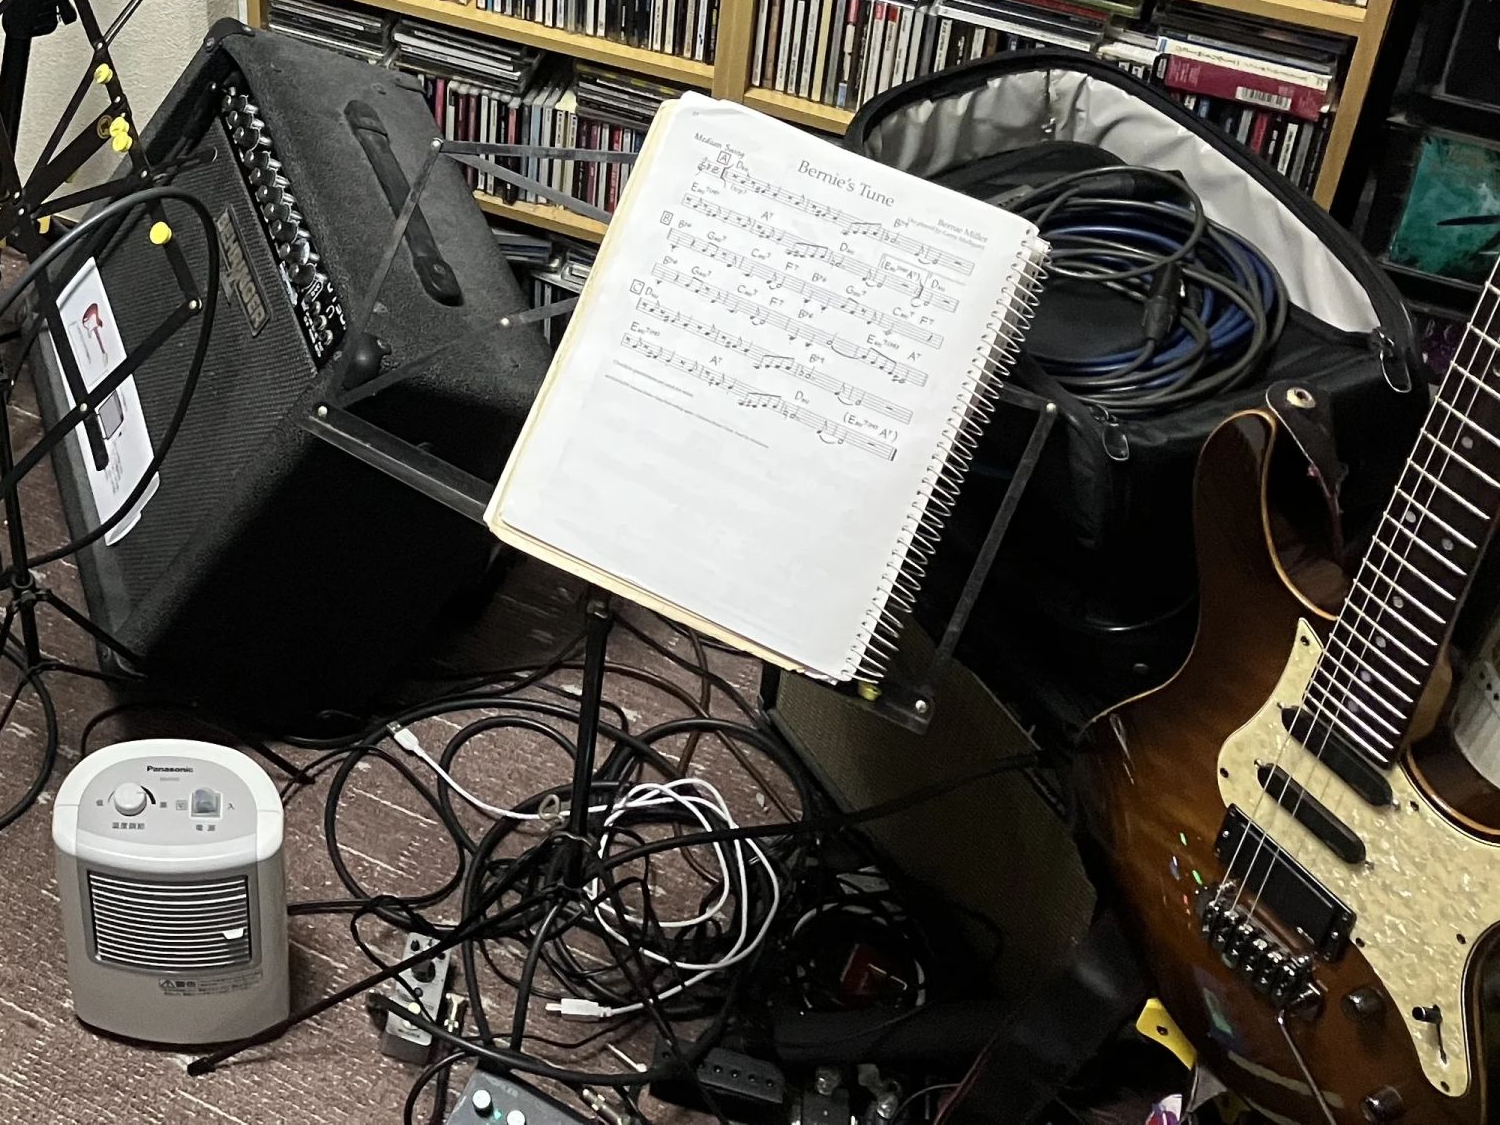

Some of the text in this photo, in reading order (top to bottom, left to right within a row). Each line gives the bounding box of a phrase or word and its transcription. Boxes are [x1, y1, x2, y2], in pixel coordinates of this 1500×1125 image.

[694, 132, 722, 149] Medium
[797, 159, 895, 207] Bernie's Tune
[963, 228, 989, 244] Miller
[214, 208, 270, 330] BEHRINGER
